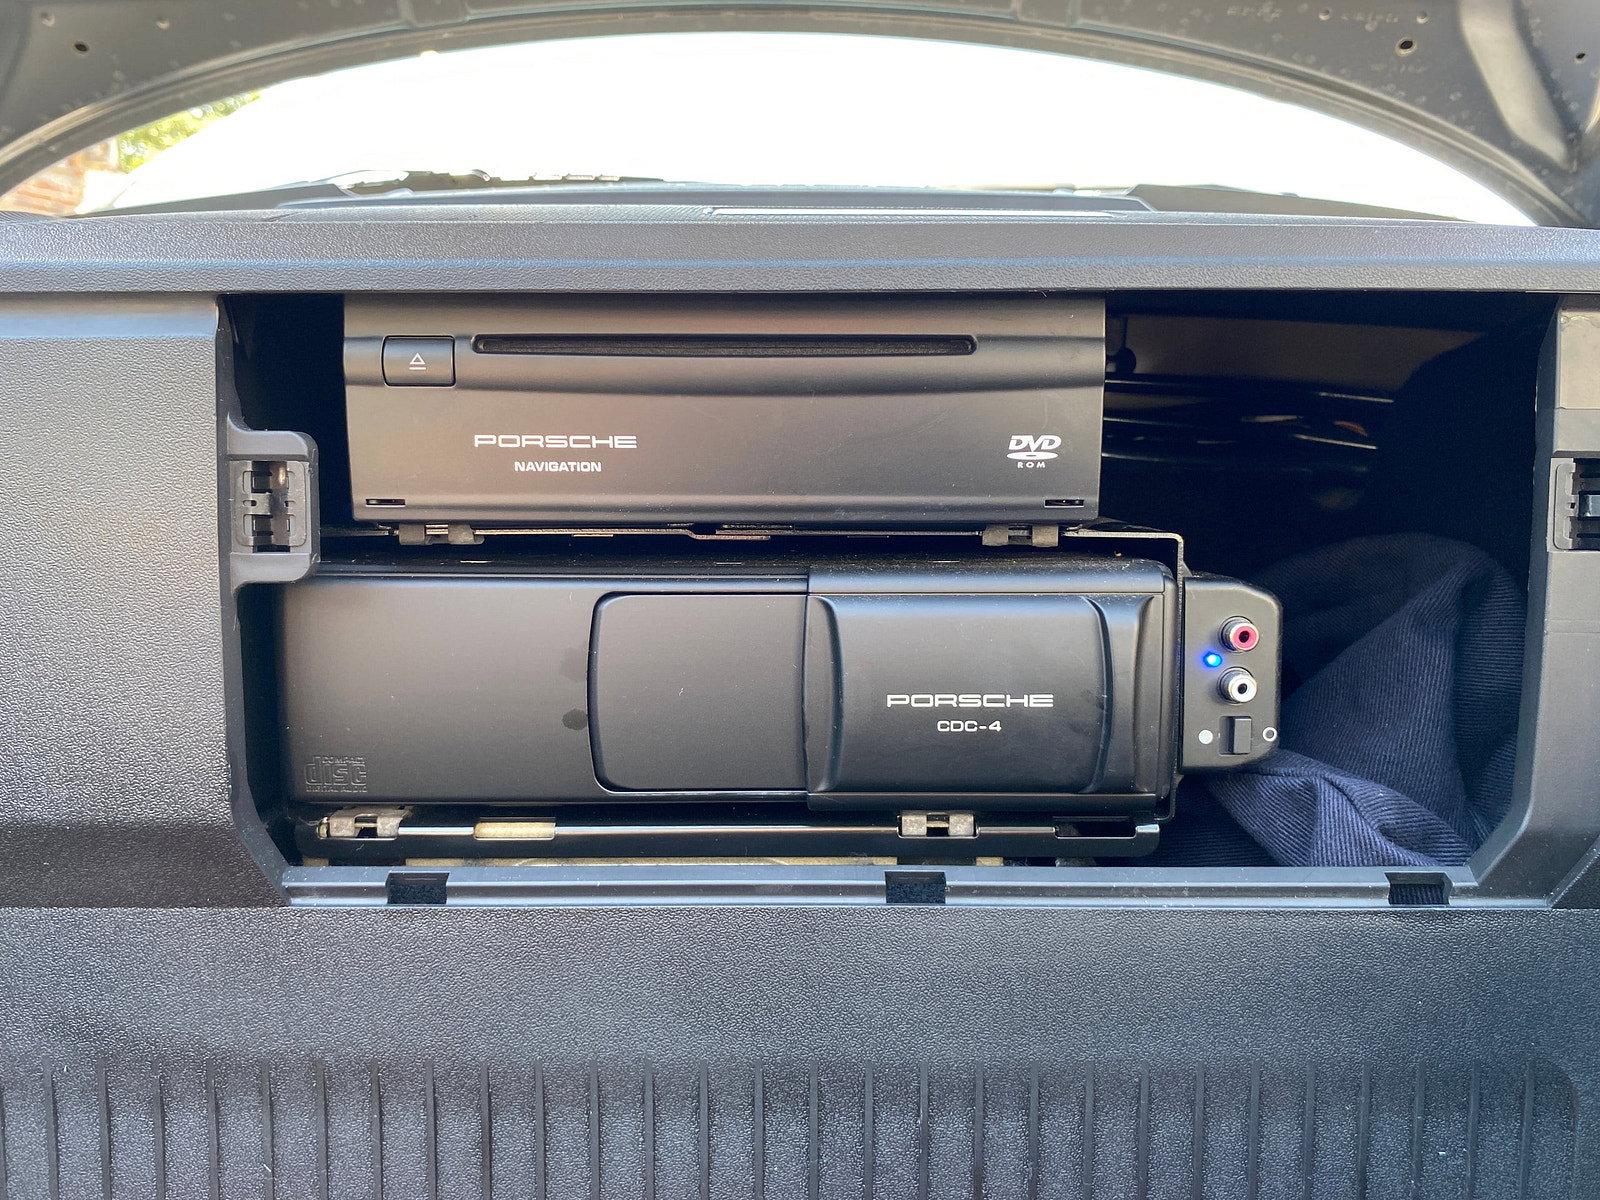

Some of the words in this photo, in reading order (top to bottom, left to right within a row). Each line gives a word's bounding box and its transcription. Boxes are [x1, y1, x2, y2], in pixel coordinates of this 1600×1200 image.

[474, 434, 637, 449] PORSCHE
[1008, 434, 1062, 452] DVD
[514, 461, 601, 472] NAVIGATION
[886, 694, 1054, 708] PORSCHE
[937, 720, 1002, 732] CDC-4
